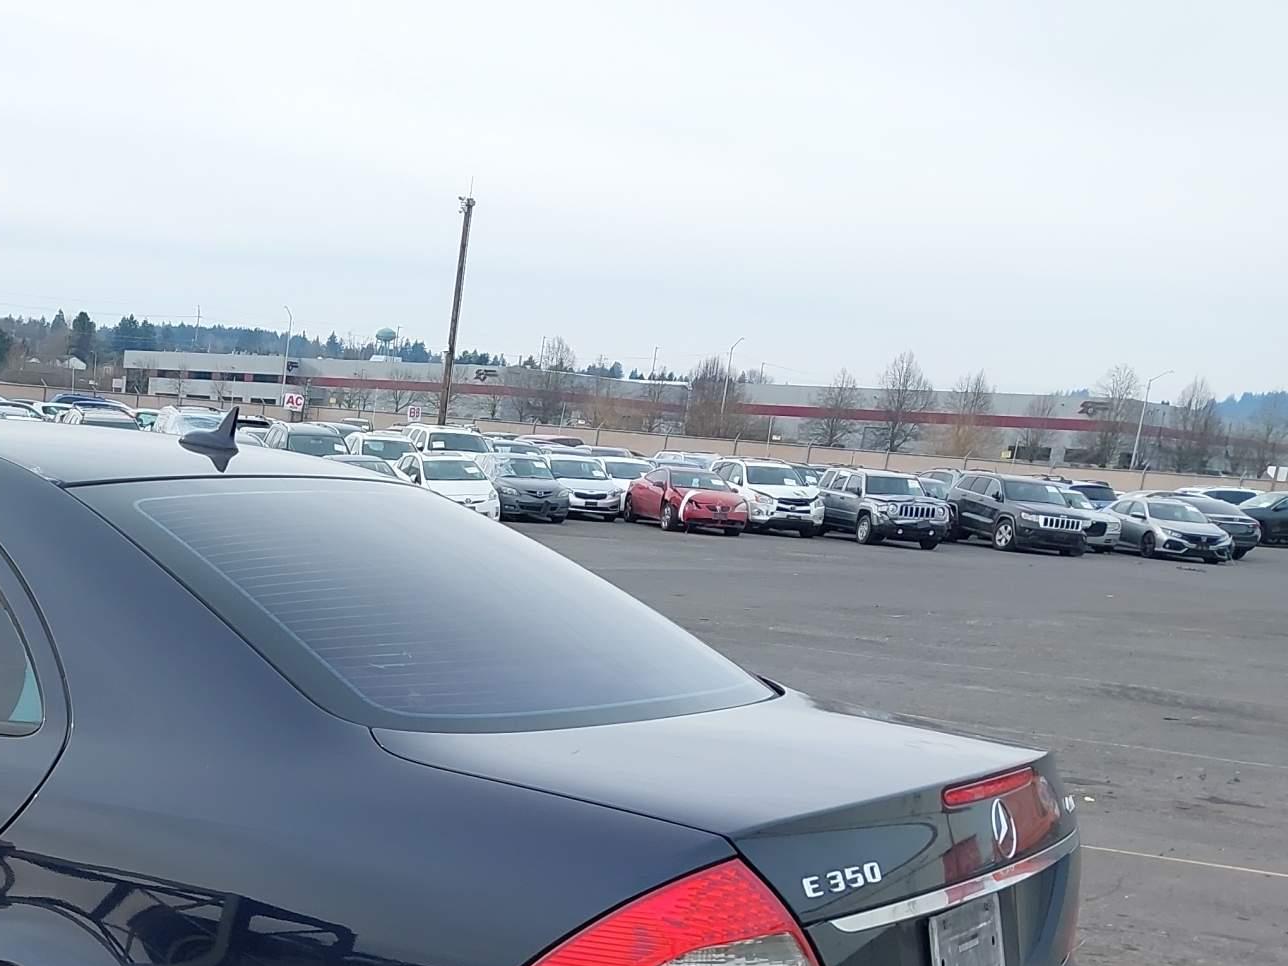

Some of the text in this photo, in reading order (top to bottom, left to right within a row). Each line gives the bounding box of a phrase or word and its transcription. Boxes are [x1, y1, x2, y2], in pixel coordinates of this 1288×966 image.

[286, 395, 303, 406] AC
[802, 861, 882, 898] E 350
